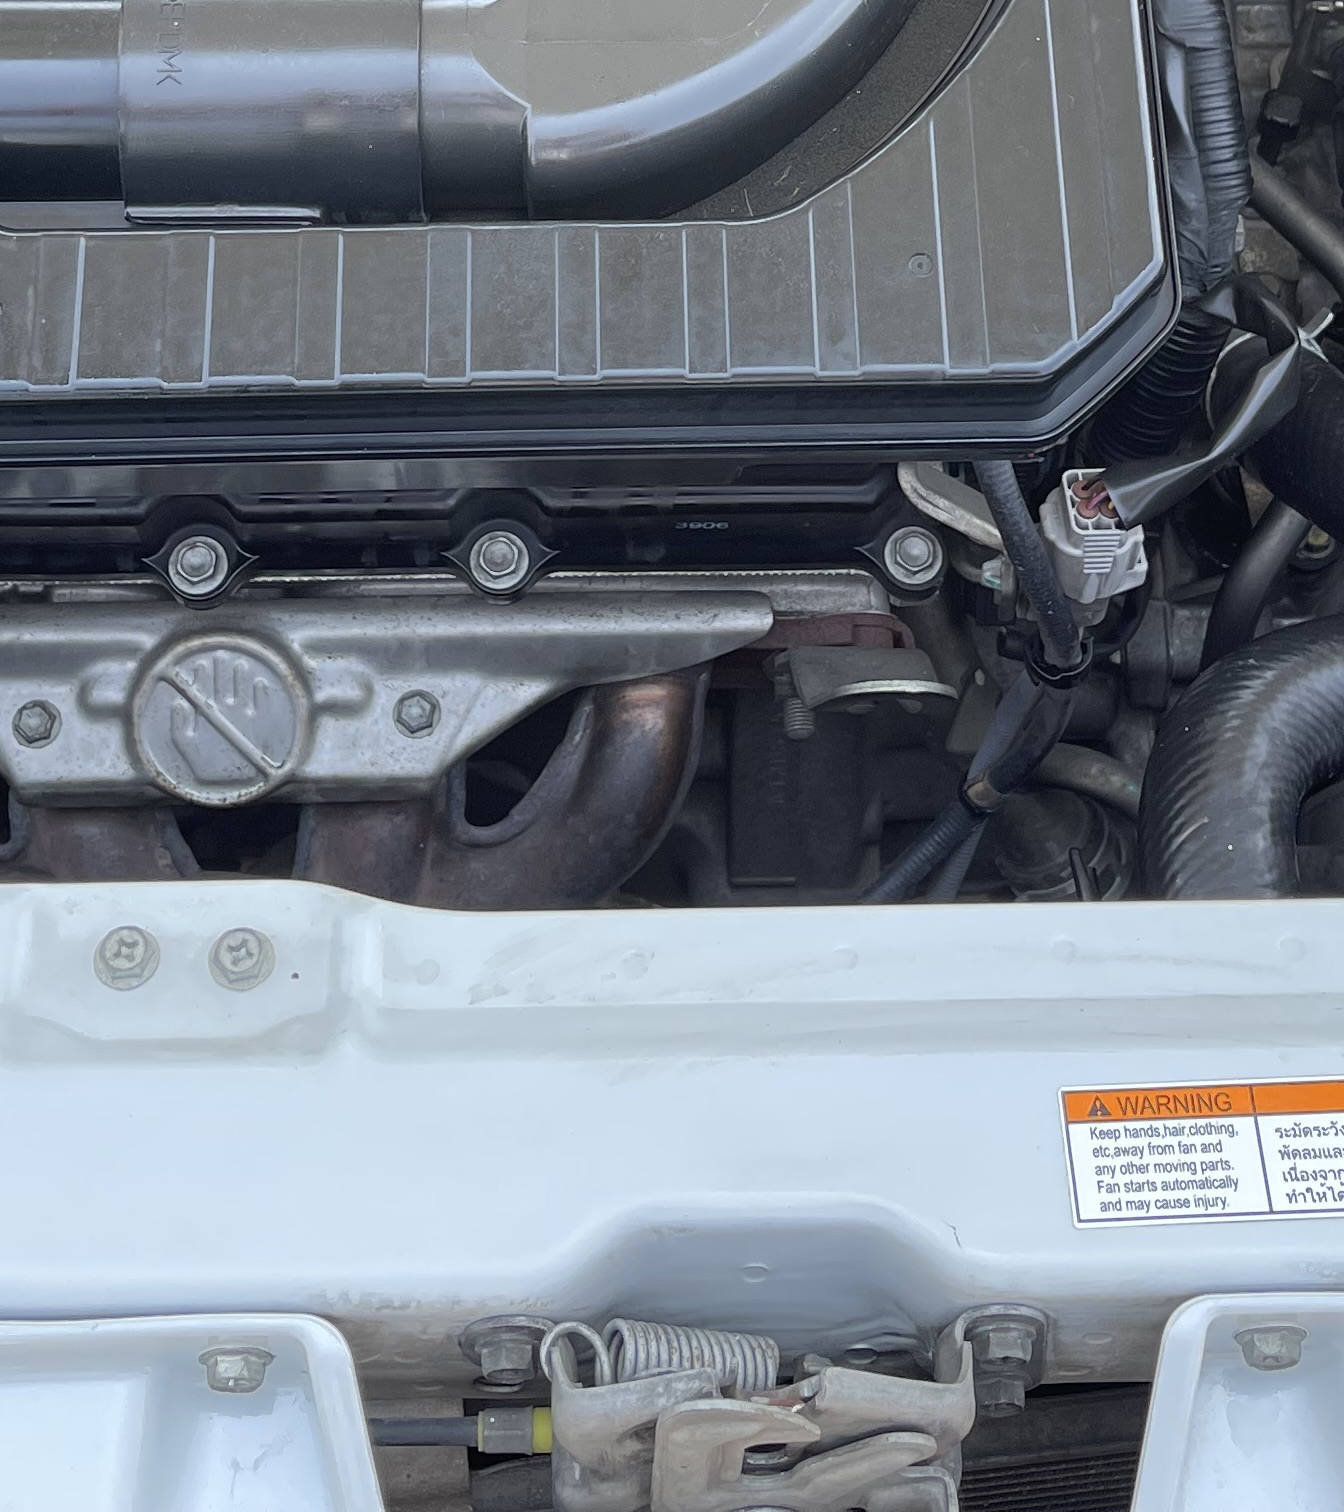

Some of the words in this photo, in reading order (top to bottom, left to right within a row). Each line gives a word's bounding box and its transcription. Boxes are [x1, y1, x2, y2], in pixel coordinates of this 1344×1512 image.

[1116, 1092, 1233, 1116] WARNING
[1089, 1126, 1121, 1142] Keep
[1147, 1141, 1175, 1156] from
[1178, 1140, 1197, 1155] fan
[1200, 1139, 1223, 1154] and
[1094, 1164, 1116, 1179] any
[1119, 1161, 1150, 1175] other
[1154, 1160, 1198, 1176] moving
[1200, 1157, 1235, 1175] parts.
[1097, 1179, 1121, 1194] Fan
[1124, 1178, 1158, 1194] starts
[1160, 1174, 1239, 1193] automatically
[1099, 1197, 1123, 1213] and
[1125, 1198, 1151, 1214] may
[1154, 1196, 1191, 1210] cause
[1193, 1194, 1230, 1211] injury.
